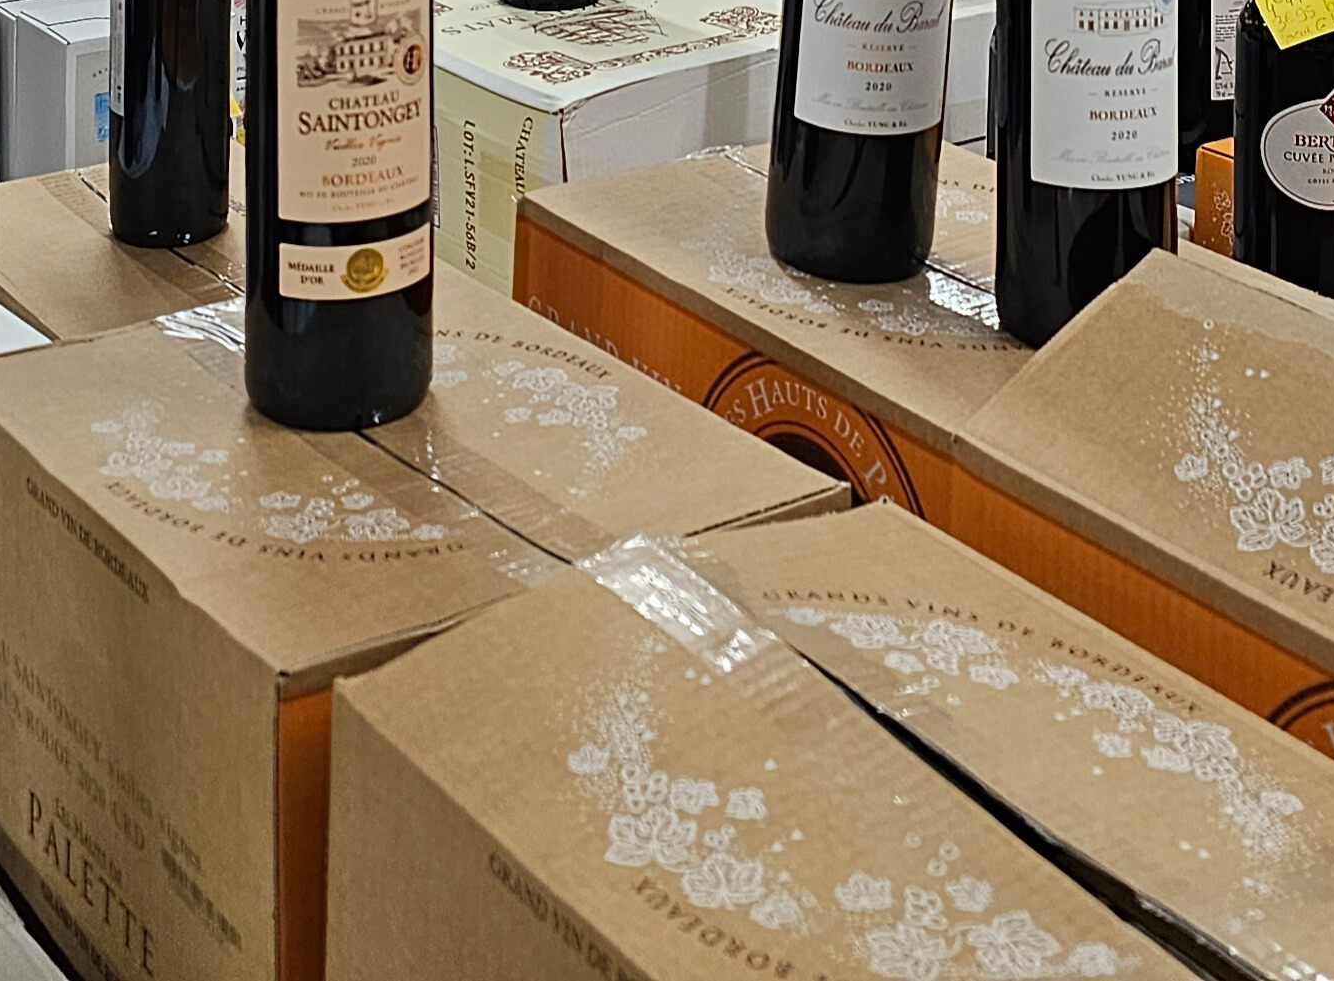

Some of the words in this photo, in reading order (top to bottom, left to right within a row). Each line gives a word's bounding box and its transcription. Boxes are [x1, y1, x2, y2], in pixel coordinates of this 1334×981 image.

[874, 13, 894, 33] du
[846, 60, 914, 74] BORDEAUX
[1045, 38, 1111, 76] Château
[1115, 50, 1134, 76] du
[866, 81, 893, 92] 2020
[328, 91, 400, 110] CHATEAU
[298, 98, 422, 136] SAINTONGEY
[1090, 107, 1158, 121] BORDEAUX
[1112, 131, 1137, 140] 2020
[515, 116, 534, 194] CHATEAU
[1283, 149, 1325, 163] CUVÉE
[321, 167, 403, 188] BORDEAUX
[300, 274, 325, 286] D'OR
[509, 335, 610, 380] BORDEAUX
[746, 378, 828, 423] HAUTS
[834, 416, 866, 455] DE
[212, 528, 245, 547] DE
[260, 543, 324, 563] VINS
[93, 541, 150, 603] BORDEAUX
[765, 589, 889, 605] GRANDS
[908, 599, 979, 620] VINS
[28, 789, 154, 977] PALETTE
